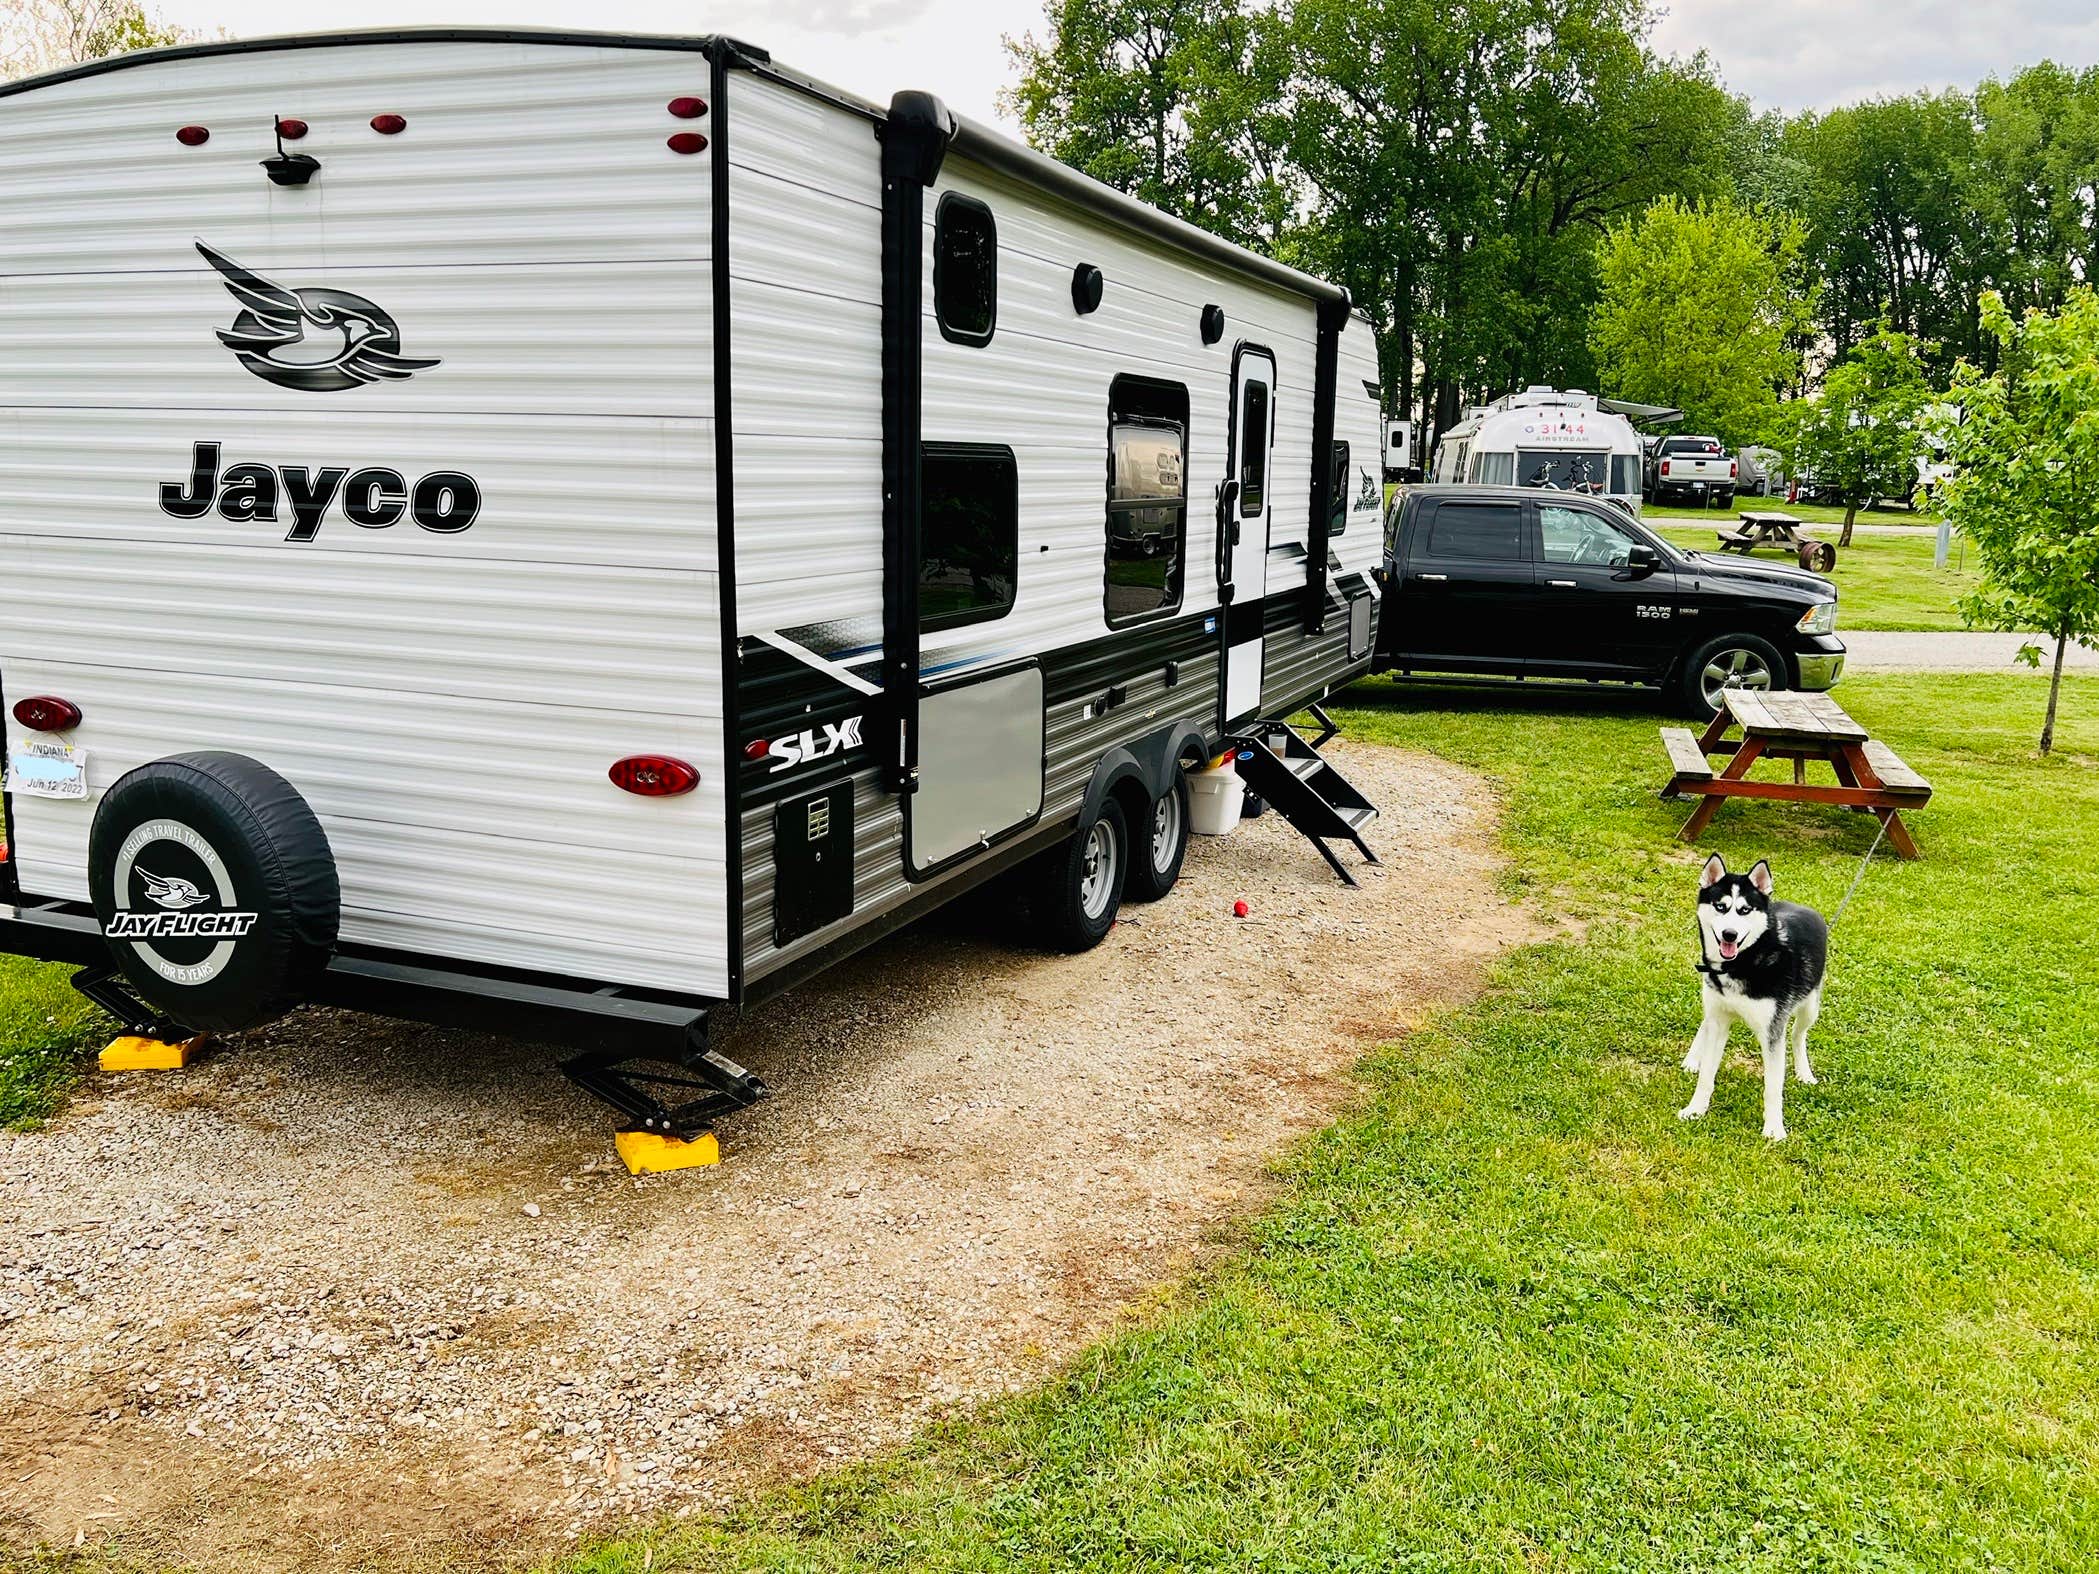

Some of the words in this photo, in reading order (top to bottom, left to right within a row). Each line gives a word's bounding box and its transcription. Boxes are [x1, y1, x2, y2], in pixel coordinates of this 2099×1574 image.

[159, 441, 482, 543] Jayco
[1636, 605, 1672, 613] RAM
[1636, 611, 1671, 619] 1500
[32, 743, 70, 758] INDIANA
[768, 715, 864, 773] SLX
[27, 778, 45, 790] Jun
[47, 779, 57, 791] 12
[62, 782, 83, 794] 2022
[126, 828, 153, 855] SELLING
[153, 824, 183, 840] TRAVEL
[183, 830, 217, 865] TRAILER
[159, 961, 176, 979] FOR
[177, 969, 186, 981] 15
[186, 961, 214, 981] YEARS
